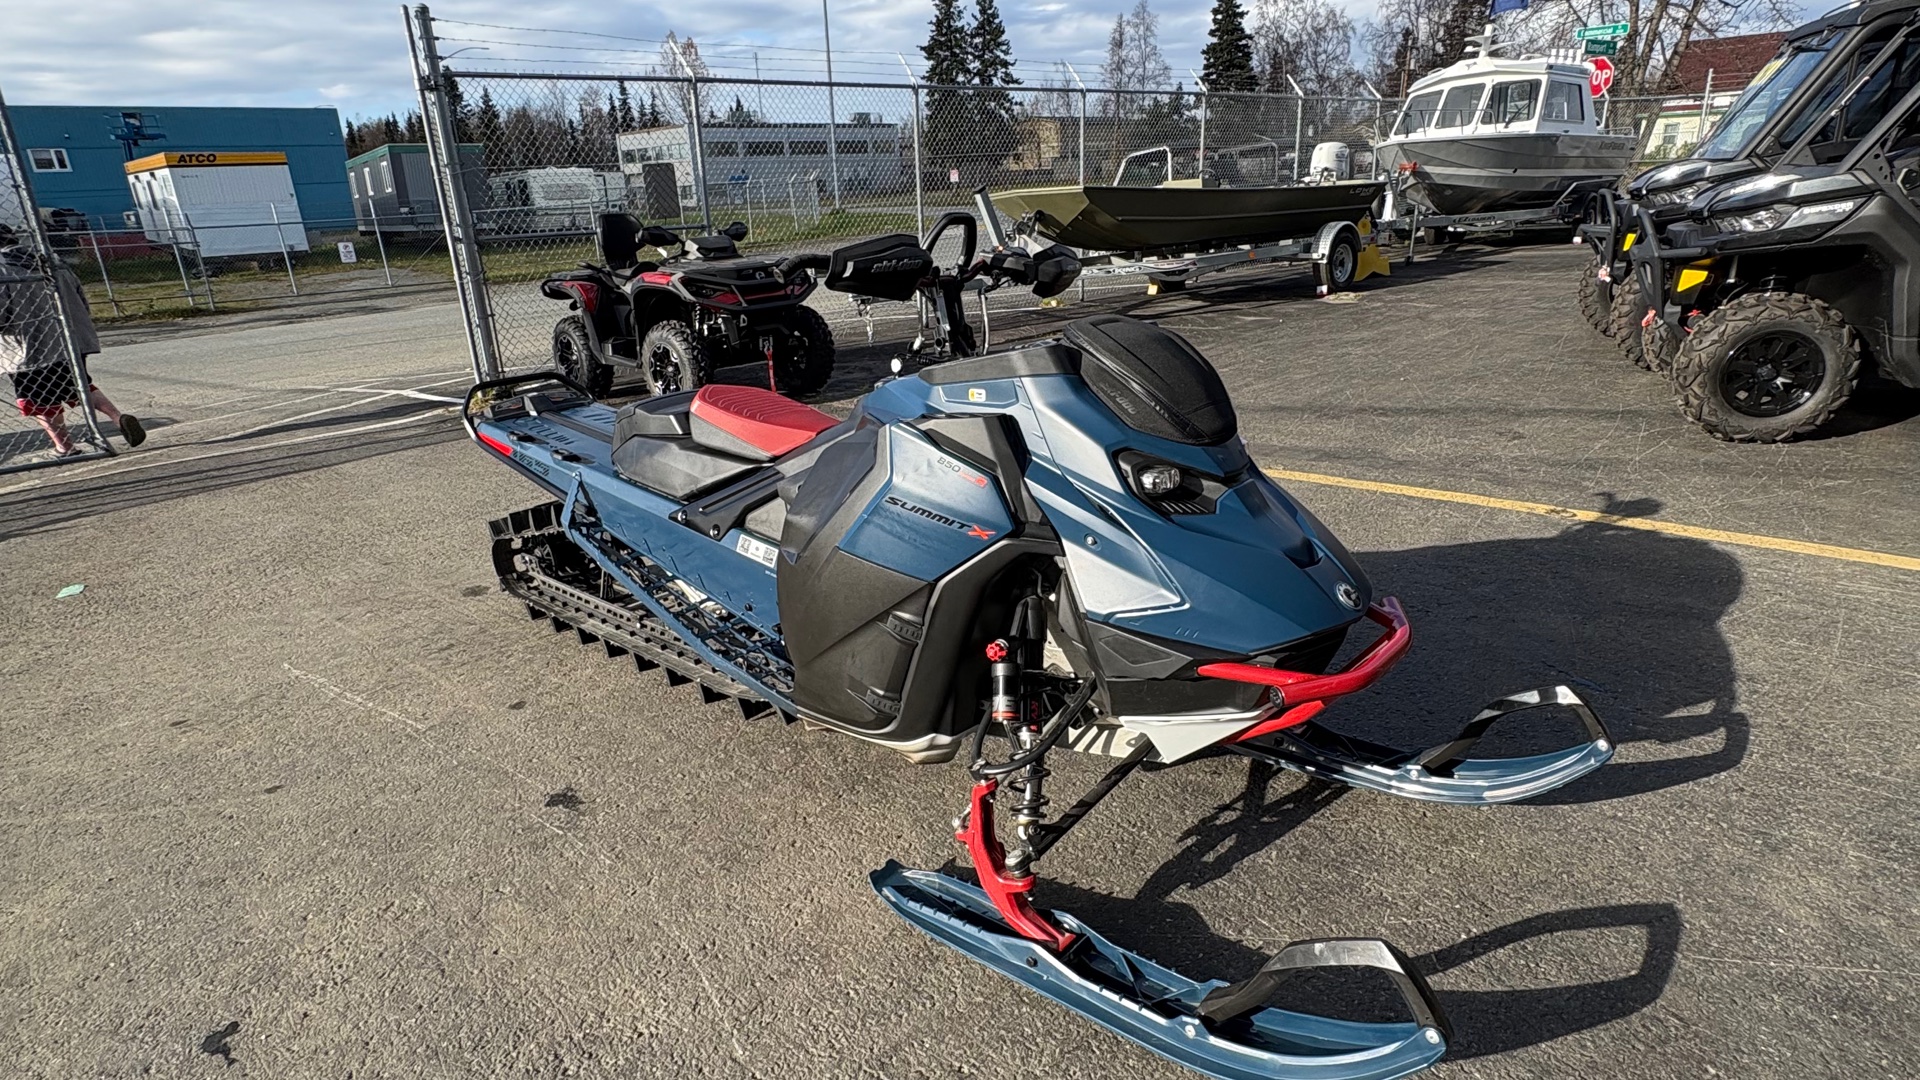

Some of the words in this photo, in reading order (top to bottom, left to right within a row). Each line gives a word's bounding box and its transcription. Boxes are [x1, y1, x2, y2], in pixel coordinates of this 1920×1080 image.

[1592, 69, 1611, 86] OP
[177, 153, 217, 164] ATCO
[937, 456, 962, 473] 850
[884, 495, 972, 530] SUMMIT
